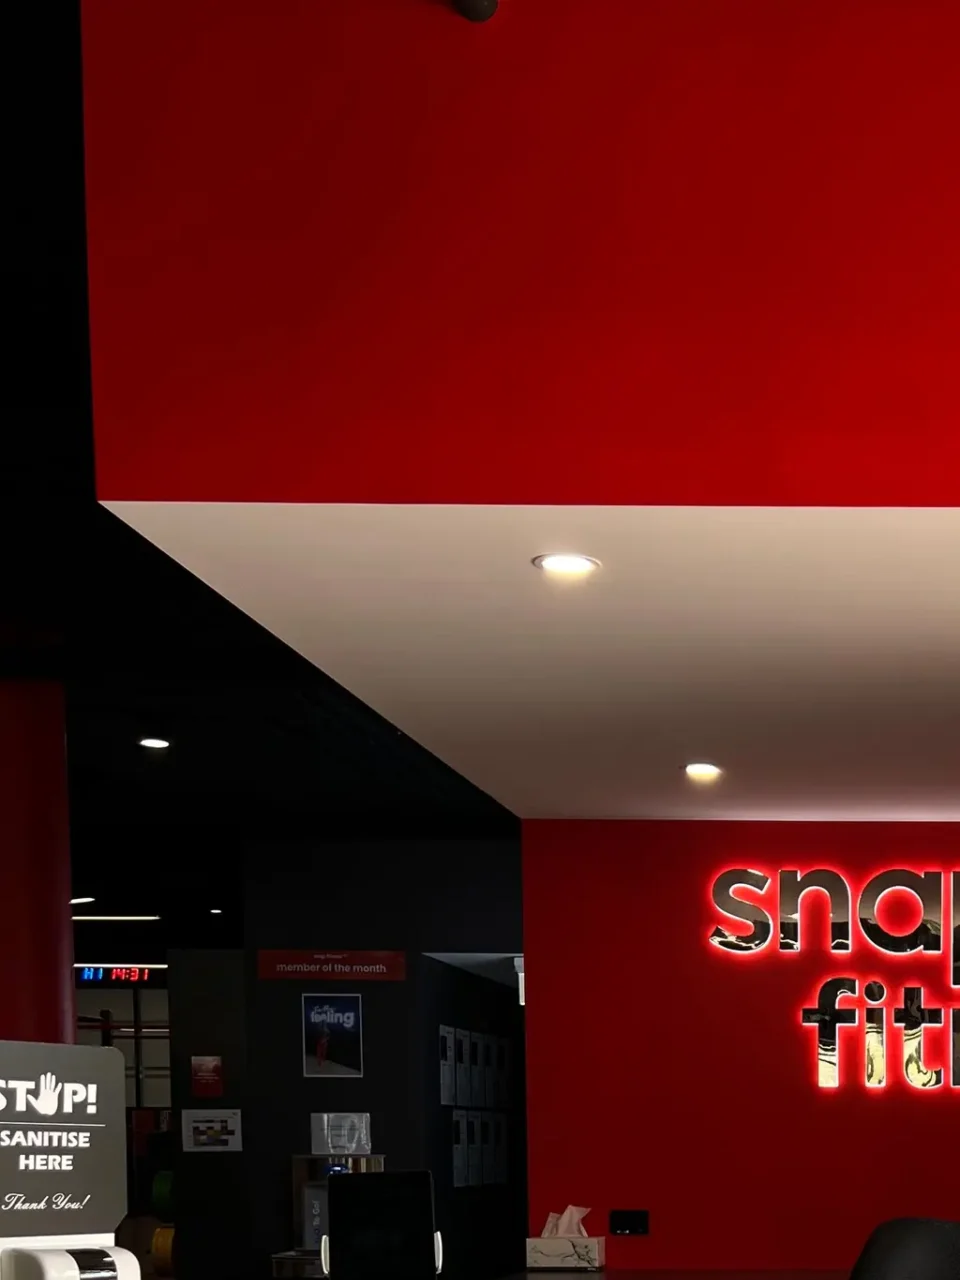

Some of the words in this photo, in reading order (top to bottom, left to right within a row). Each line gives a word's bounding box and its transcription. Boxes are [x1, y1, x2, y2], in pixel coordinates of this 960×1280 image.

[112, 967, 149, 981] 14:31
[276, 963, 320, 973] member
[321, 963, 332, 973] of
[334, 963, 350, 973] the
[352, 963, 387, 974] month
[310, 1010, 355, 1028] feeling
[0, 1130, 91, 1148] SANITISE
[18, 1154, 74, 1171] HERE
[1, 1192, 48, 1211] Thank
[52, 1192, 91, 1210] You!
